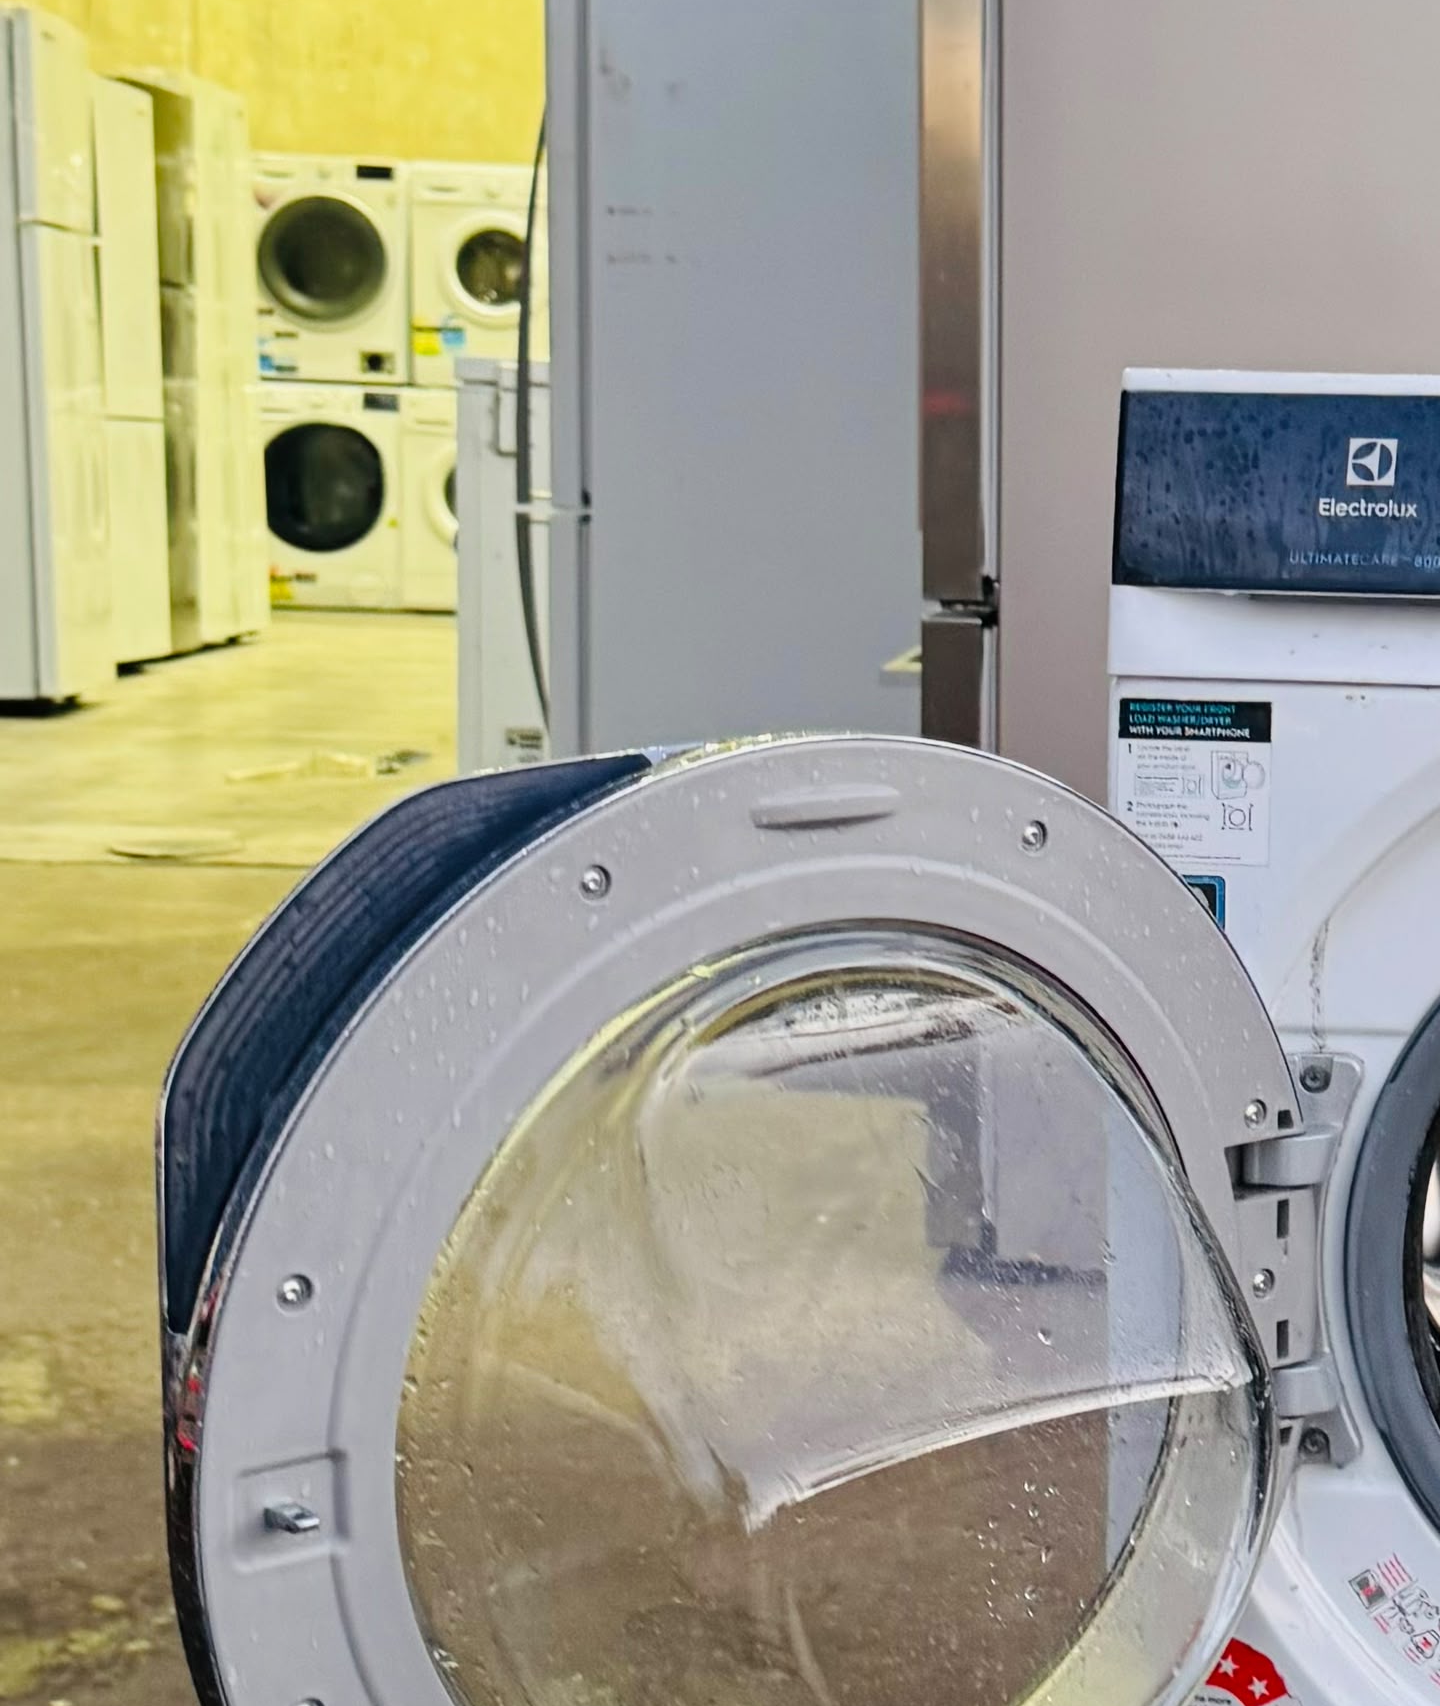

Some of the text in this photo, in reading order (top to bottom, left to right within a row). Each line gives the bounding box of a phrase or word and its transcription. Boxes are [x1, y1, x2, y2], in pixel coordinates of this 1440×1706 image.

[1318, 496, 1418, 519] Electrolux
[1129, 725, 1251, 738] WITH YOUR SMARTPHONE
